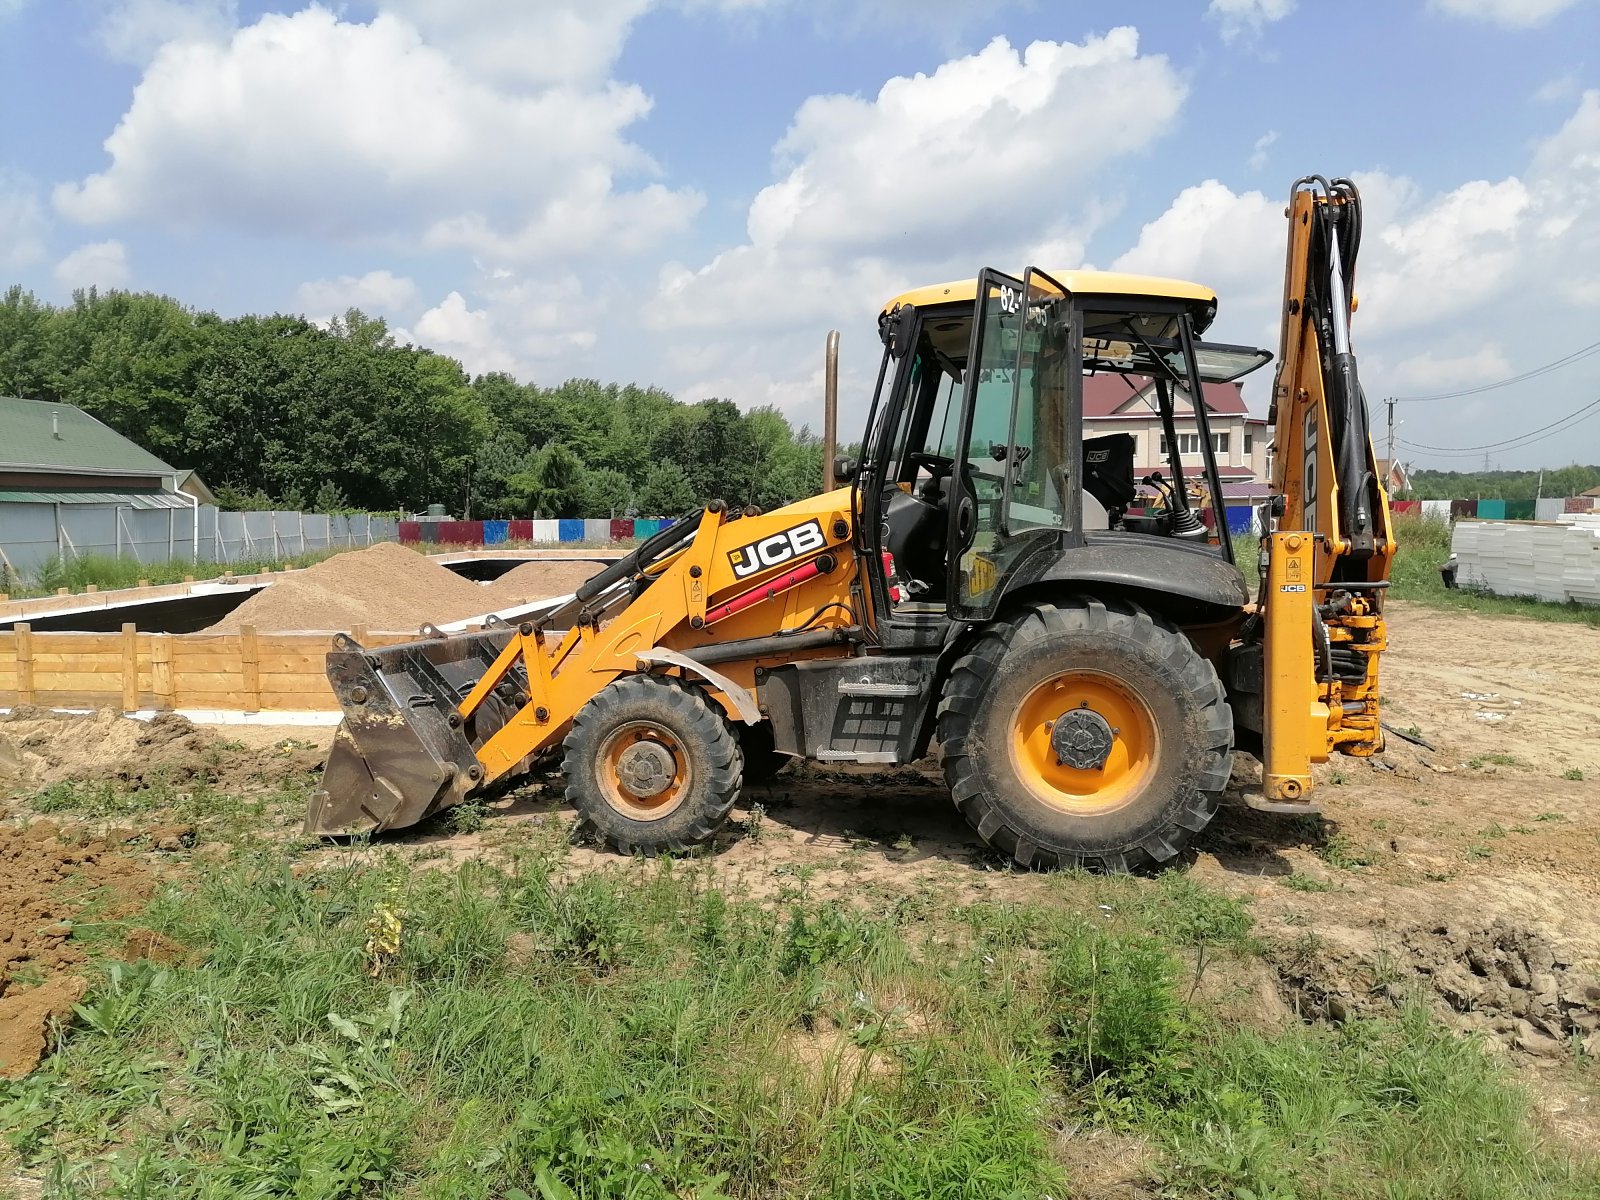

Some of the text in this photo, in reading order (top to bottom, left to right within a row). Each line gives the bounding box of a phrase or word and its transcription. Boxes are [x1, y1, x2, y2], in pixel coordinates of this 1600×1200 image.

[1089, 452, 1108, 460] JCB
[734, 522, 824, 577] JCB
[1280, 585, 1306, 593] JCB
